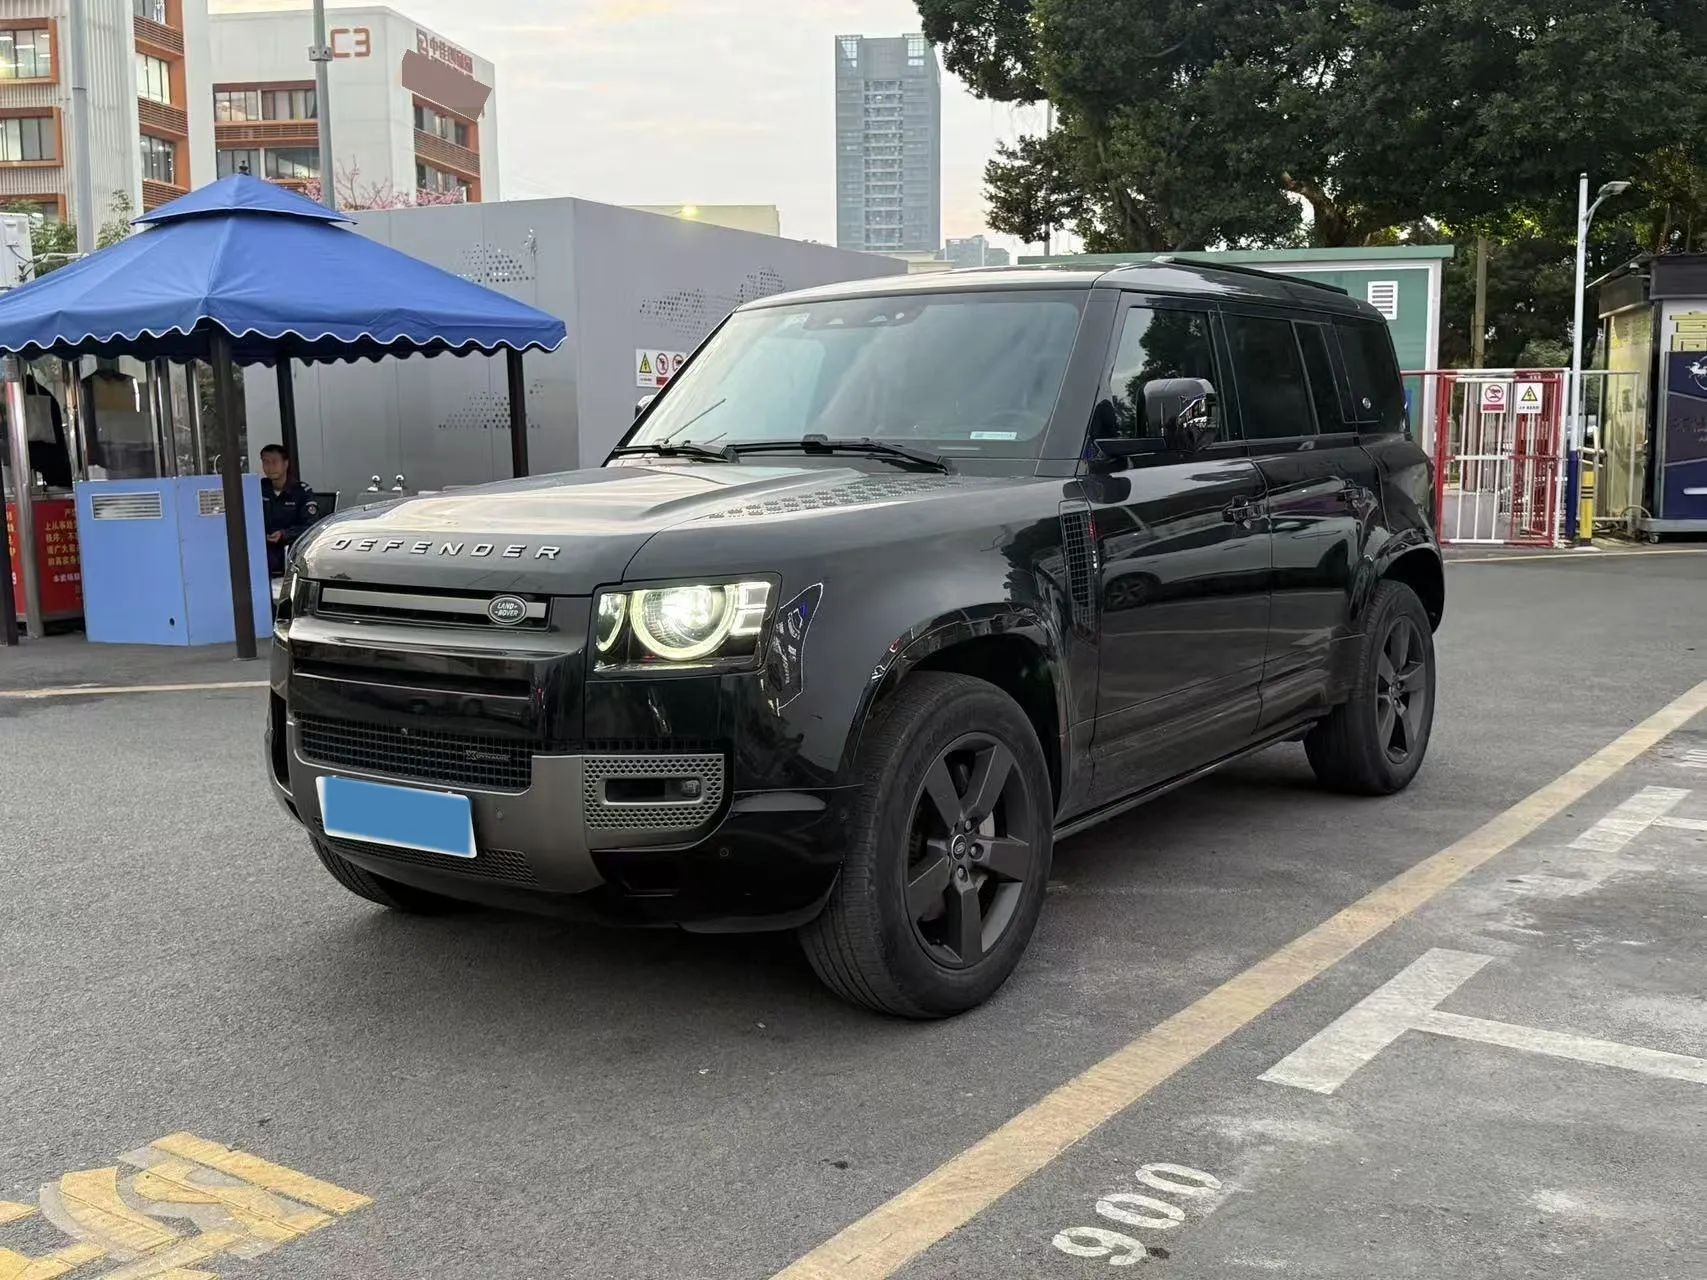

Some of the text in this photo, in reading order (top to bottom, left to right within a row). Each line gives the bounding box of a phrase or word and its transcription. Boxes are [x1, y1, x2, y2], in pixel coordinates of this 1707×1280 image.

[330, 27, 371, 58] C3
[331, 538, 560, 560] DEFENDER
[1052, 1162, 1222, 1266] 900
